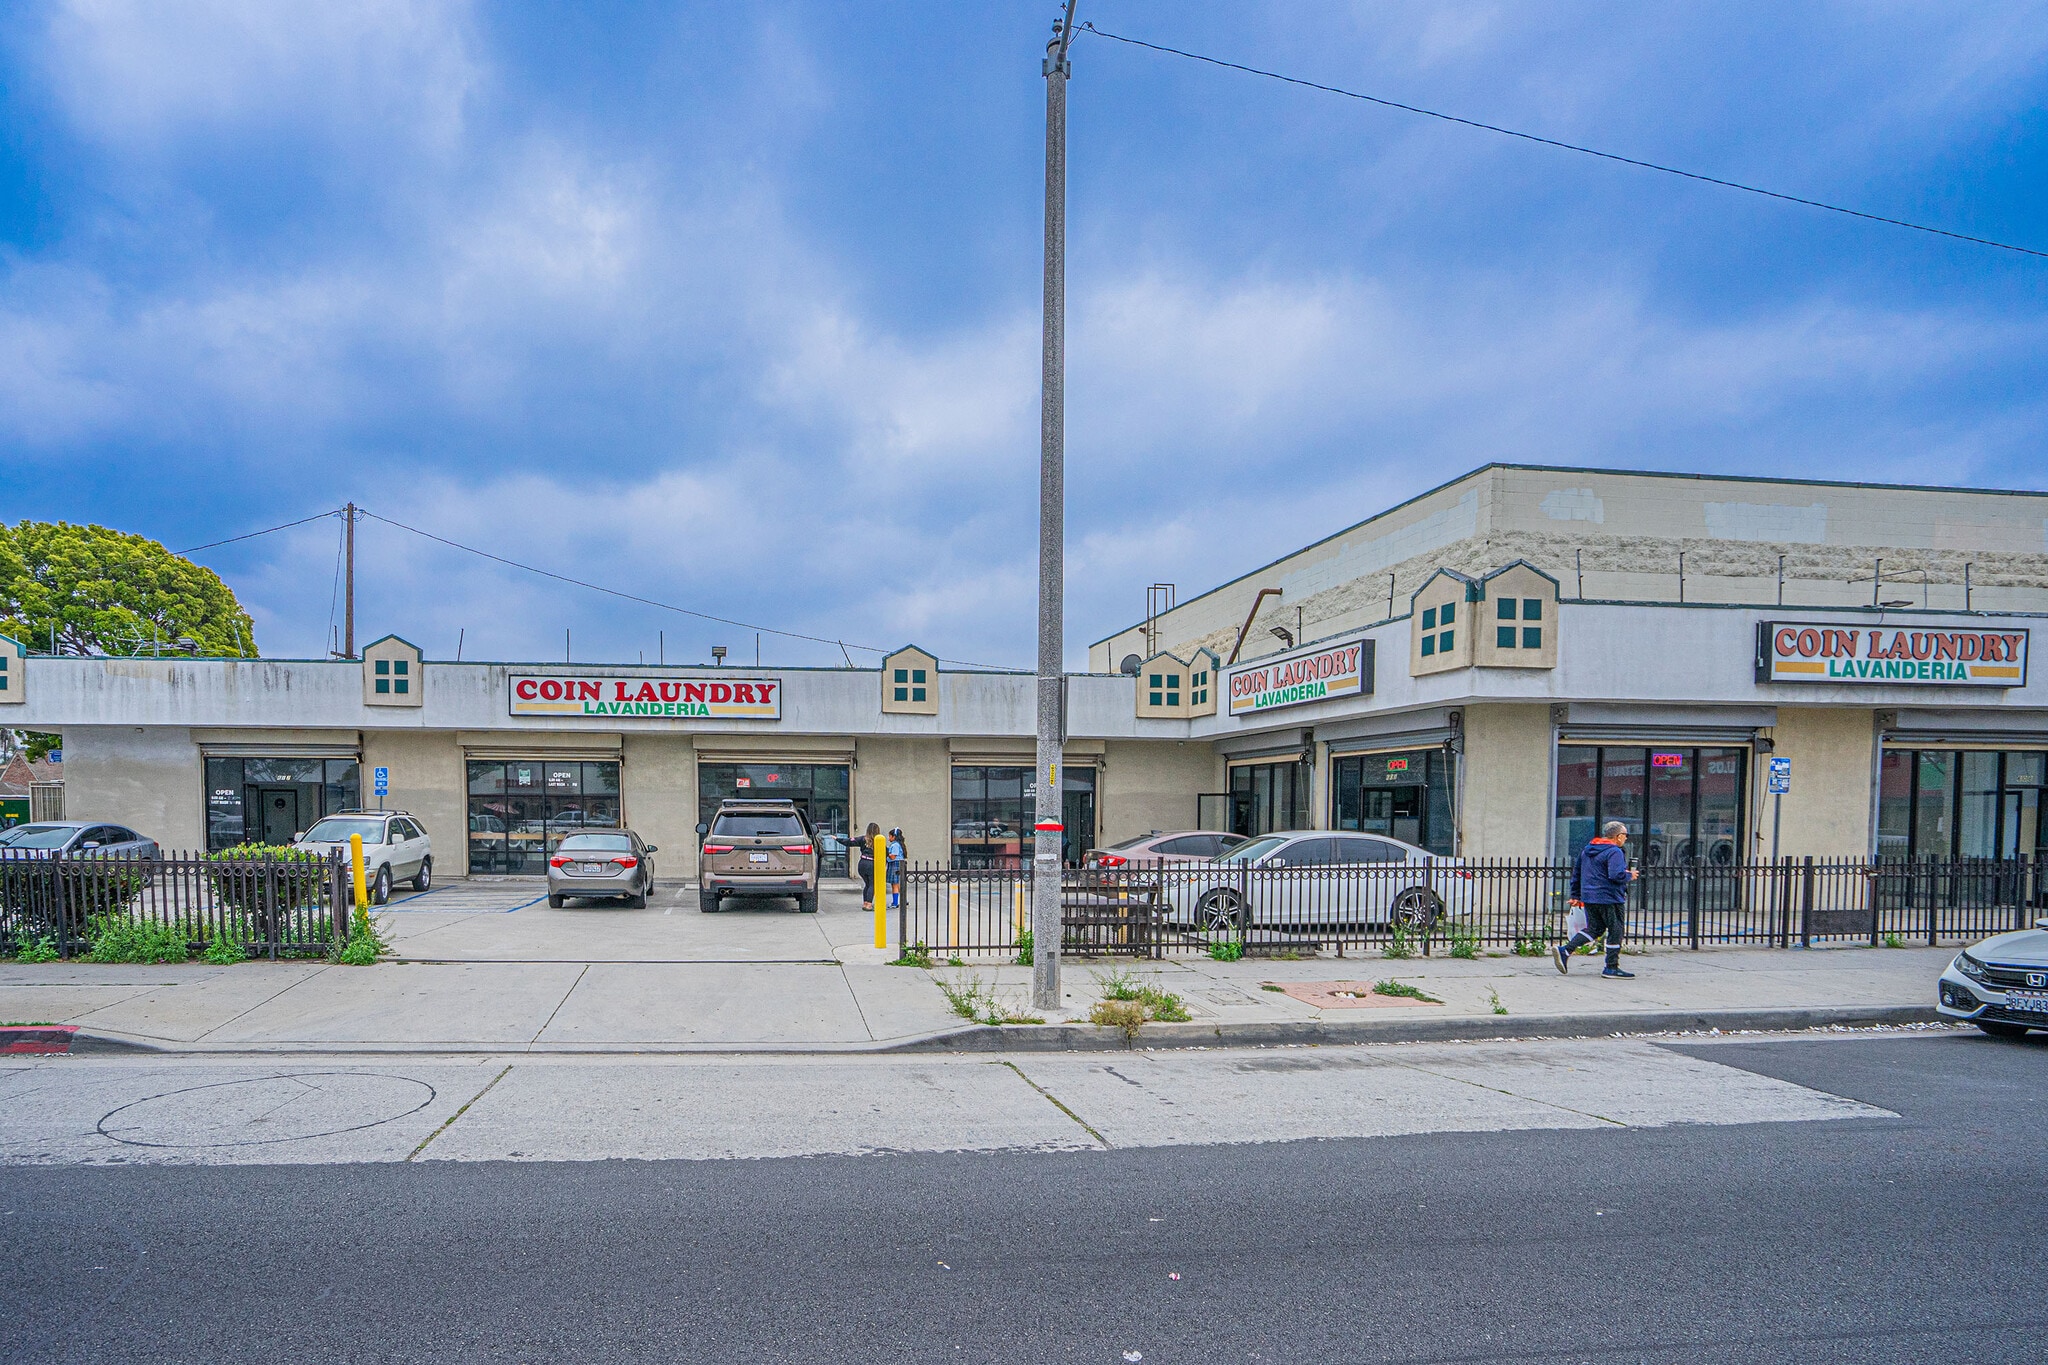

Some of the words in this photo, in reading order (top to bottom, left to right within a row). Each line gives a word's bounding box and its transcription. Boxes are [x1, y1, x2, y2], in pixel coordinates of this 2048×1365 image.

[1775, 628, 1859, 657] COIN
[1867, 631, 2024, 662] LAUNDRY
[1231, 669, 1268, 697] COIN
[1273, 646, 1360, 688] LAUNDRY
[1829, 659, 1967, 680] LAVANDERIA
[516, 680, 602, 700] COIN
[615, 681, 776, 704] LAUNDRY
[1255, 681, 1327, 708] LAVANDERIA
[584, 701, 710, 715] LAVANDERIA
[1388, 760, 1406, 770] OPEN
[1654, 755, 1681, 766] OPEN
